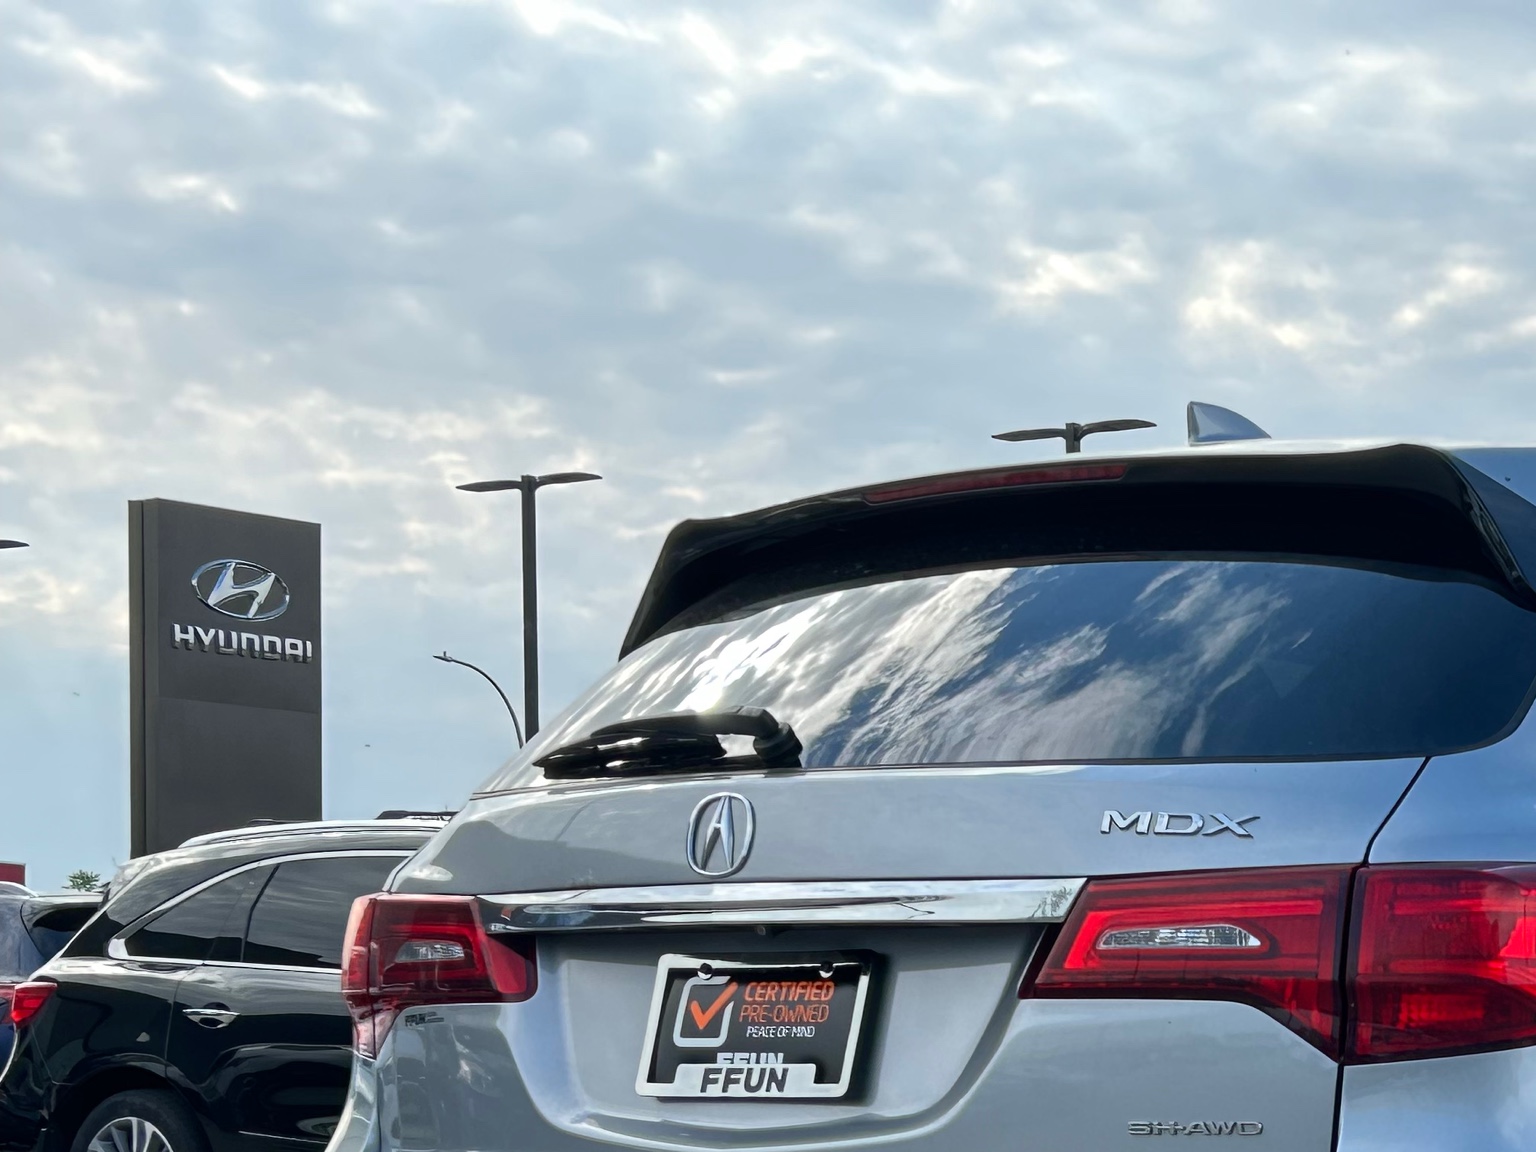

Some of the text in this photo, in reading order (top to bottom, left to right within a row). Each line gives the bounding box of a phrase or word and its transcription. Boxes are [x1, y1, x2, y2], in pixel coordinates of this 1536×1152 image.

[172, 623, 313, 663] HYUNDAI
[1101, 810, 1261, 838] MDX
[744, 981, 835, 1001] CERTIFIED
[739, 1004, 829, 1023] PRE-OWNED
[746, 1026, 816, 1038] PEACE OF MIND
[700, 1067, 789, 1093] FFUN
[1128, 1121, 1264, 1136] SH-AWD
